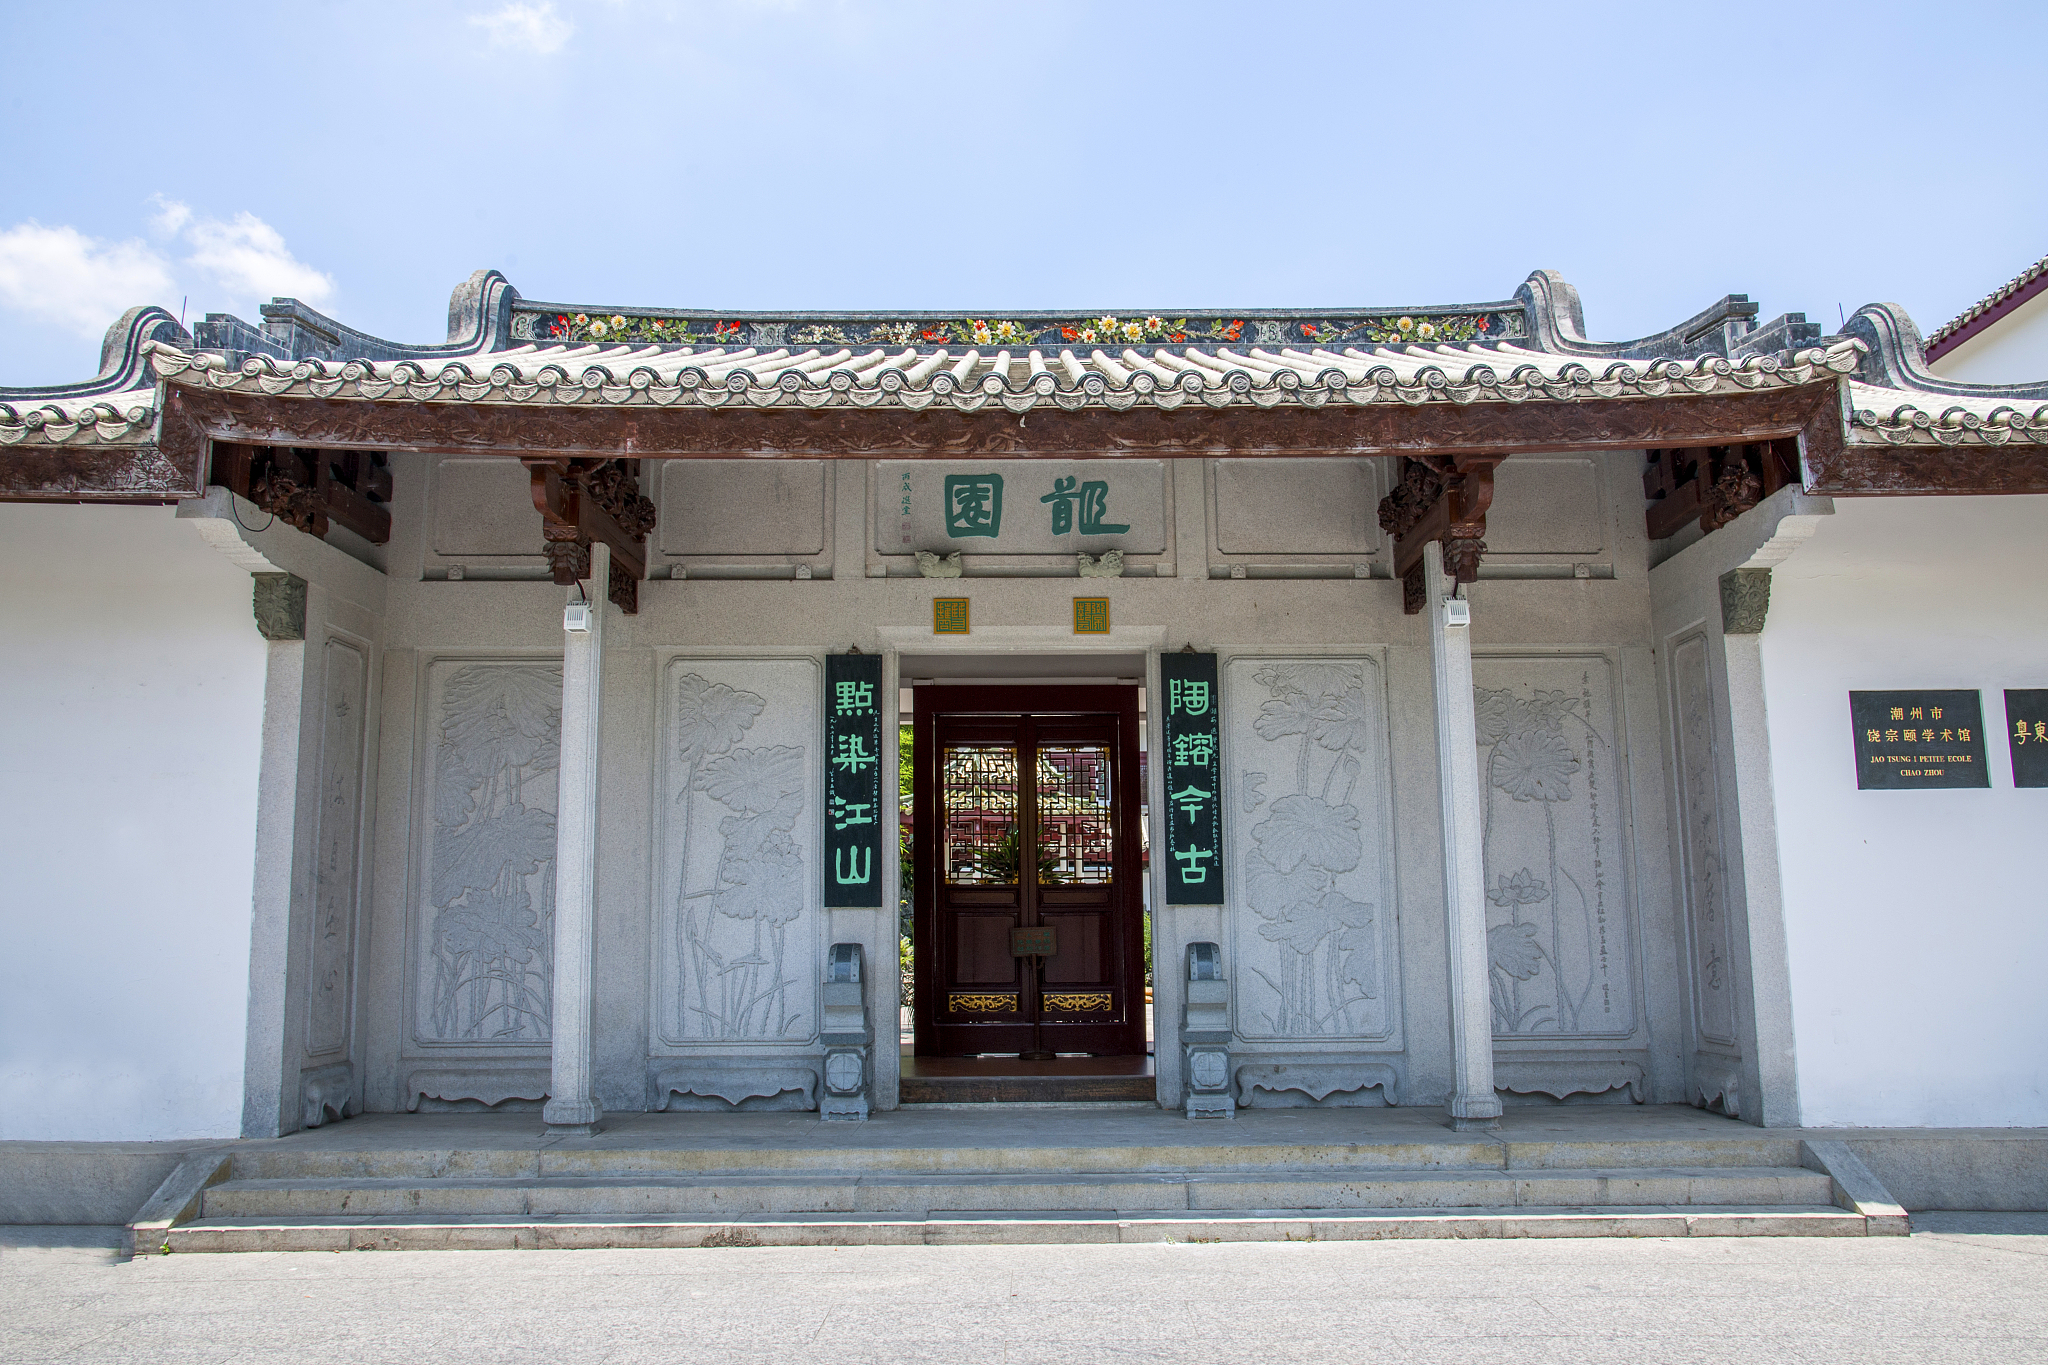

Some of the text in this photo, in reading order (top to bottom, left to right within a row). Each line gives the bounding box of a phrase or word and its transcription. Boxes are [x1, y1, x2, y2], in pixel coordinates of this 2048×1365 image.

[1890, 707, 1943, 720] 潮州市
[1867, 728, 1971, 742] 饶宗颐学术馆
[1947, 755, 1972, 763] ECOLE
[1900, 769, 1945, 777] CHAO ZHOU
